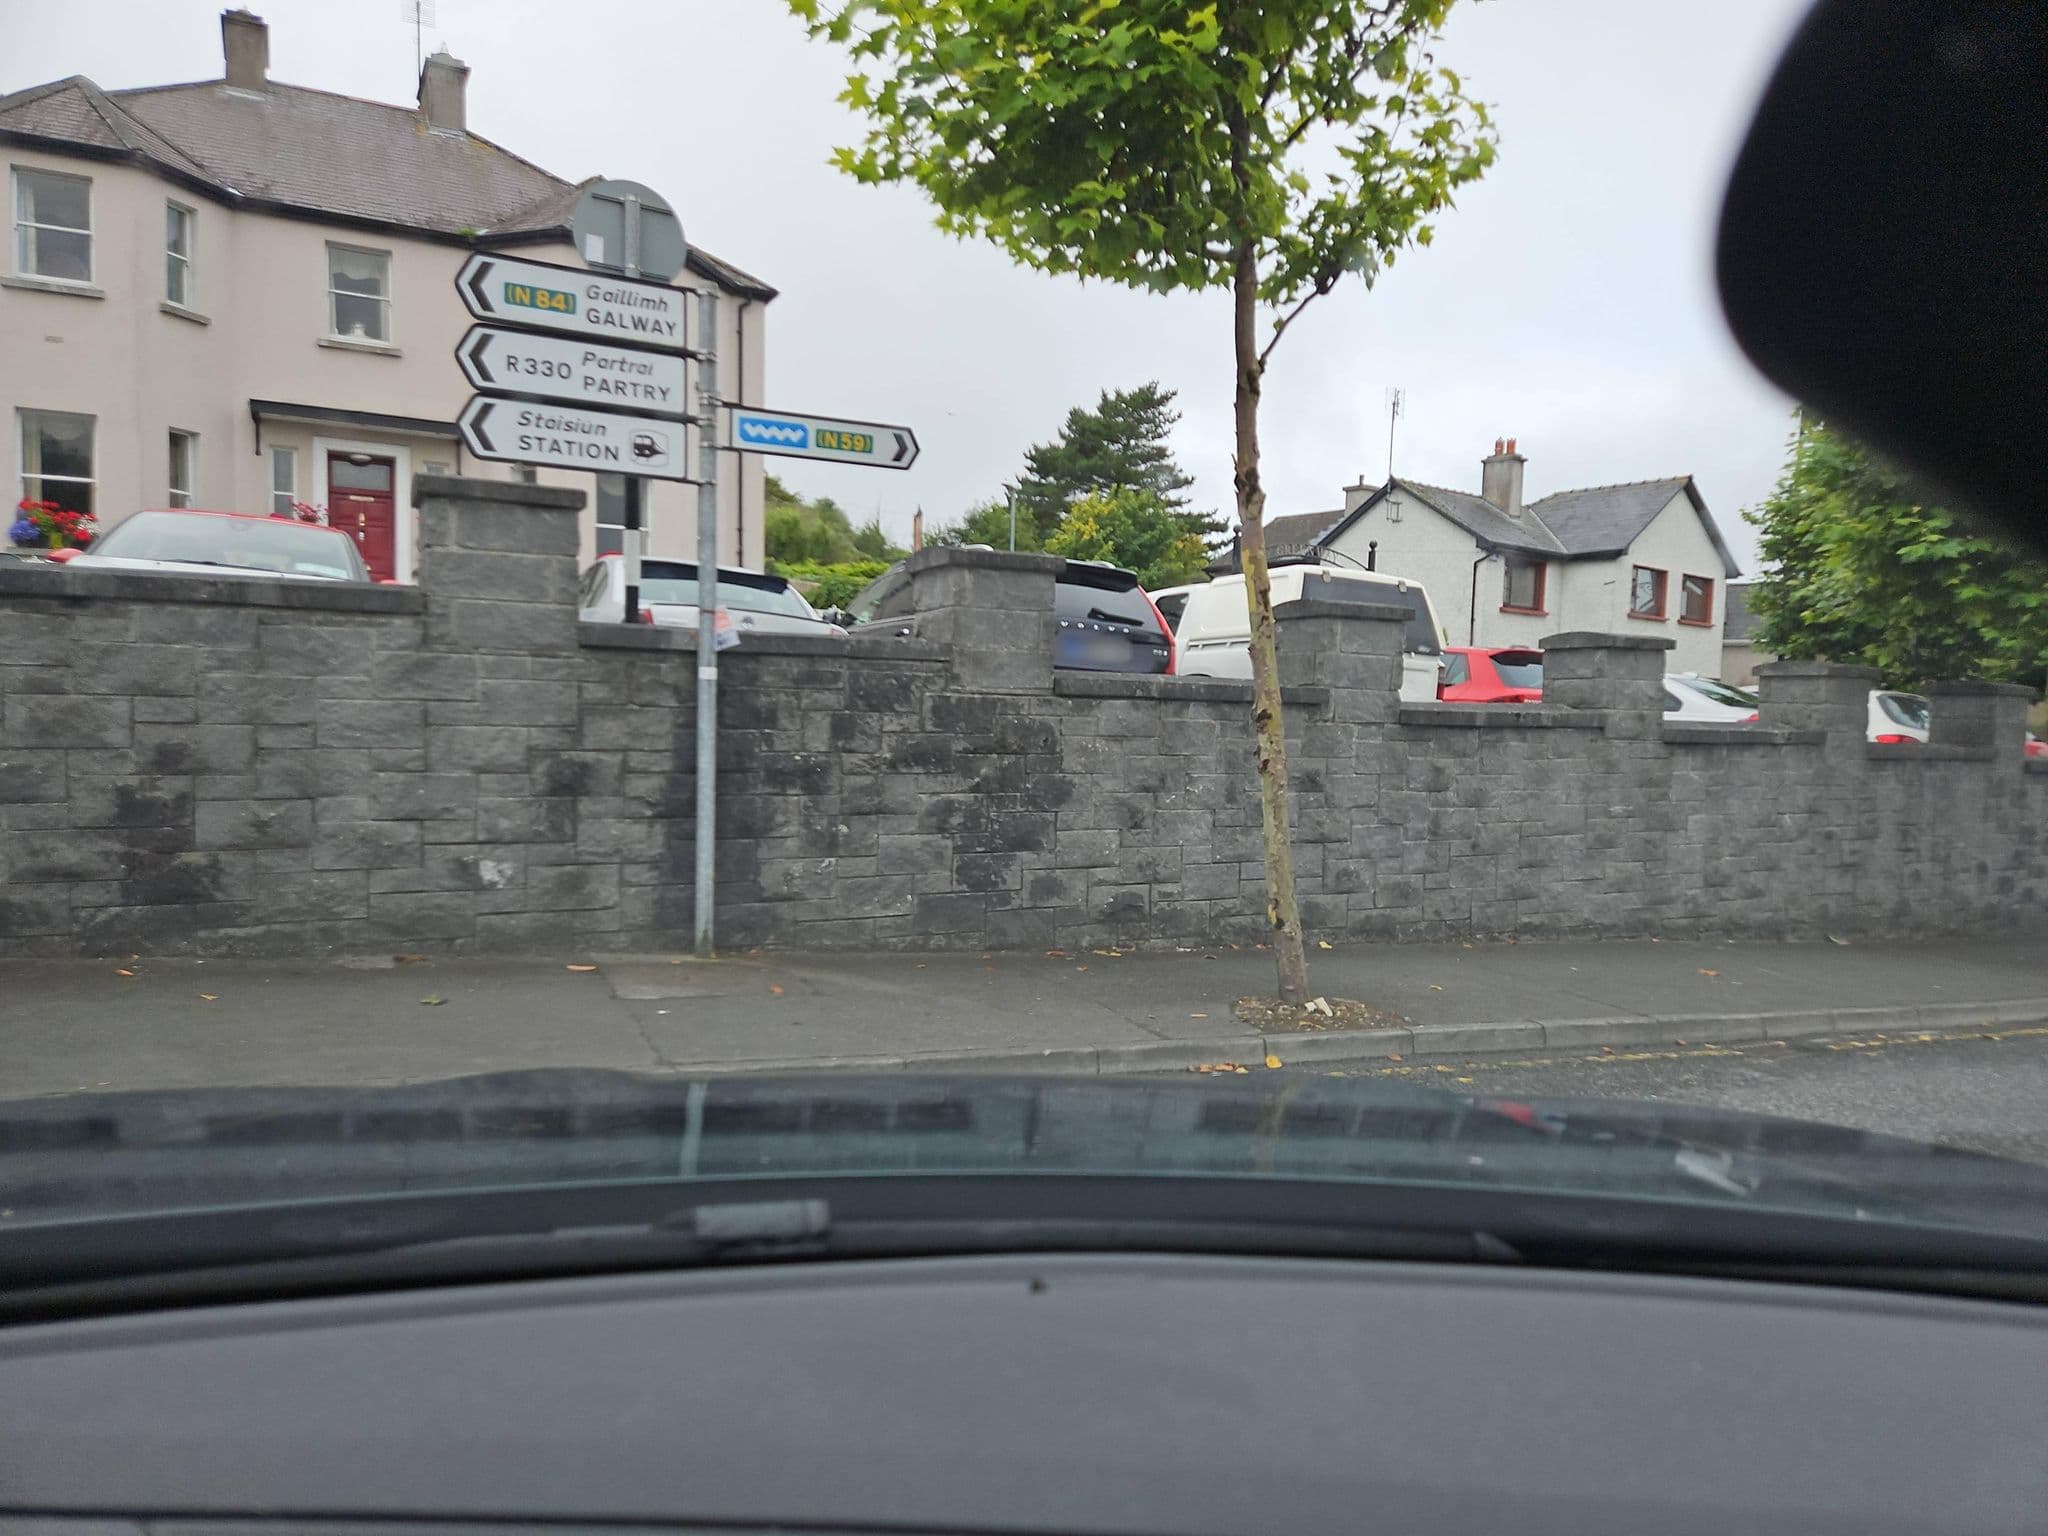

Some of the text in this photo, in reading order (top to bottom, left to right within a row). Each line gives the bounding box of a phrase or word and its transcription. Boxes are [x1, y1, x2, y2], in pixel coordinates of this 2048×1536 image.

[586, 284, 669, 313] Gaillimh
[586, 308, 677, 337] GALWAY
[506, 354, 572, 380] R330
[583, 375, 671, 402] PARTRY
[518, 435, 620, 462] STATION
